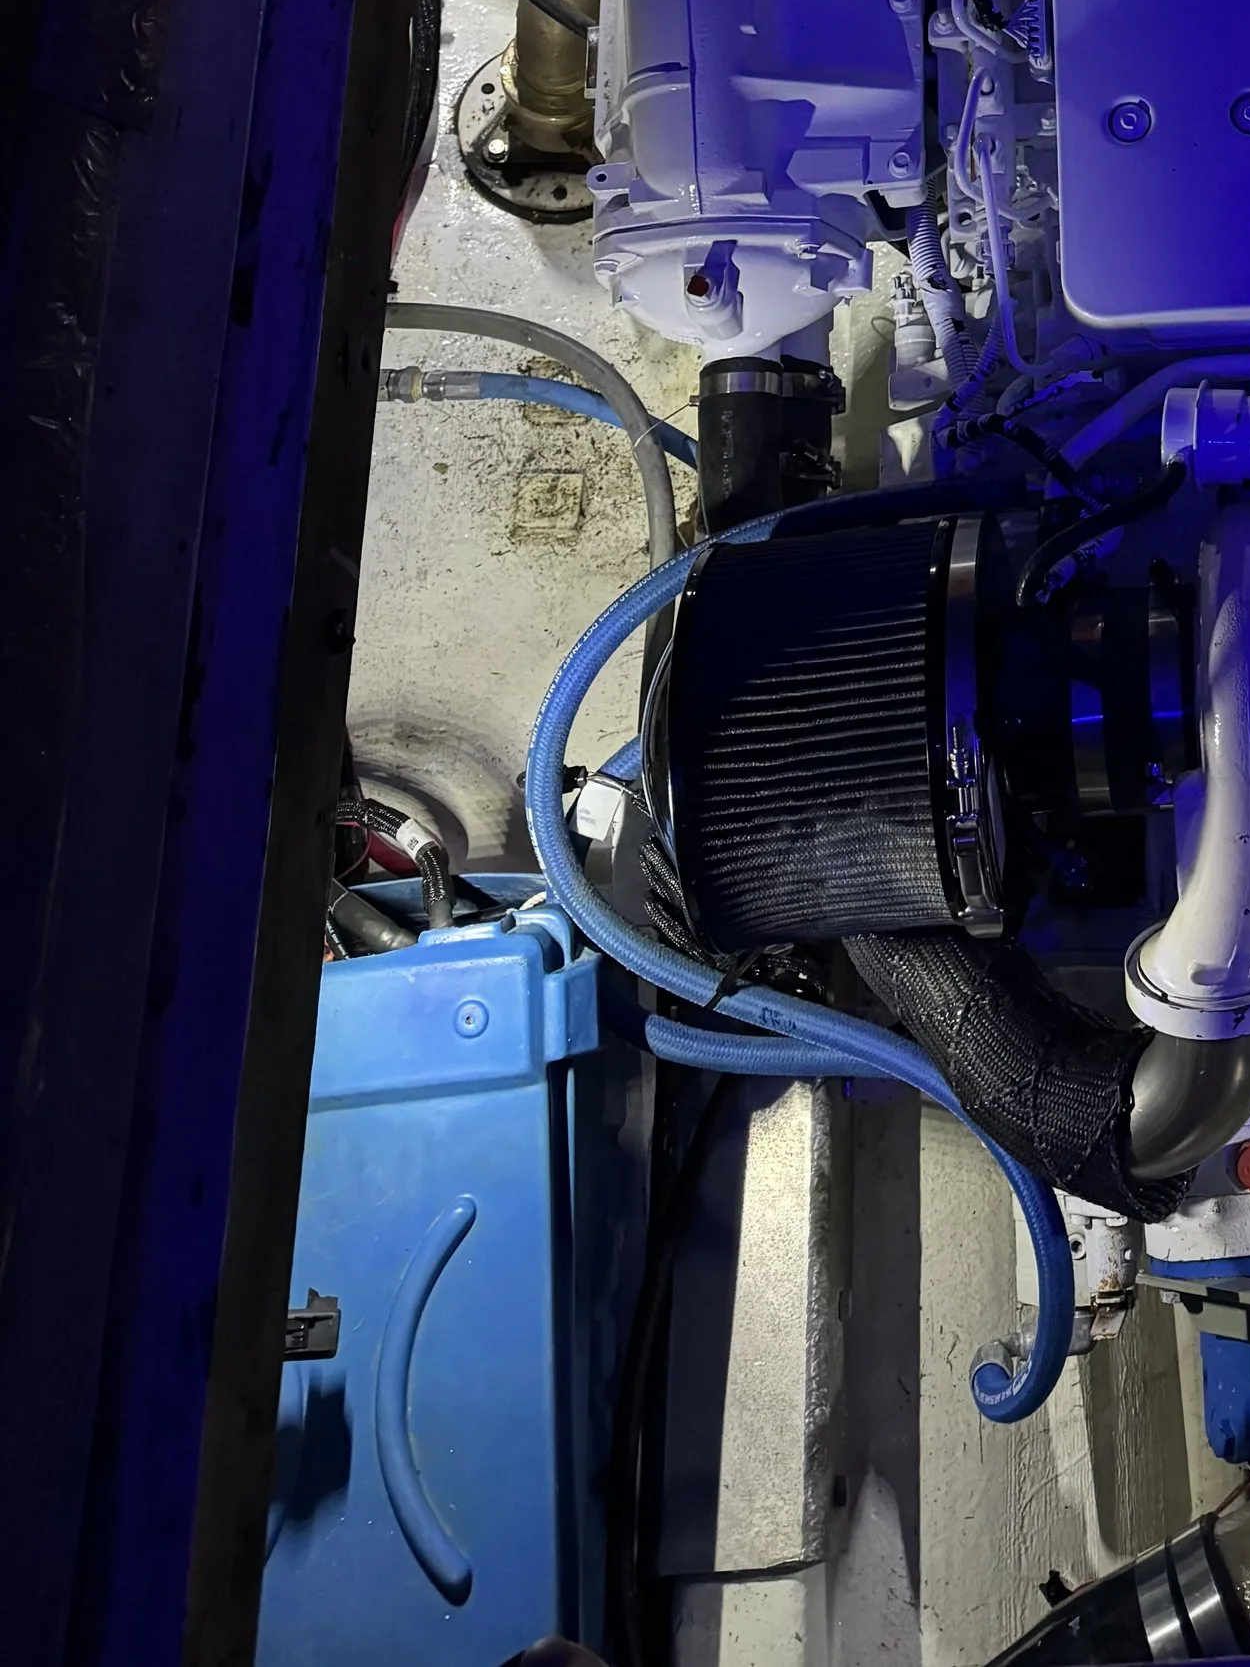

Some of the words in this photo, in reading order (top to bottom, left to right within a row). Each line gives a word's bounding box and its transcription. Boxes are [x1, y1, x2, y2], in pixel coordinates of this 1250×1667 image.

[581, 621, 599, 642] DOT
[539, 684, 557, 714] MADE
[533, 713, 545, 727] IN
[528, 727, 539, 749] USA
